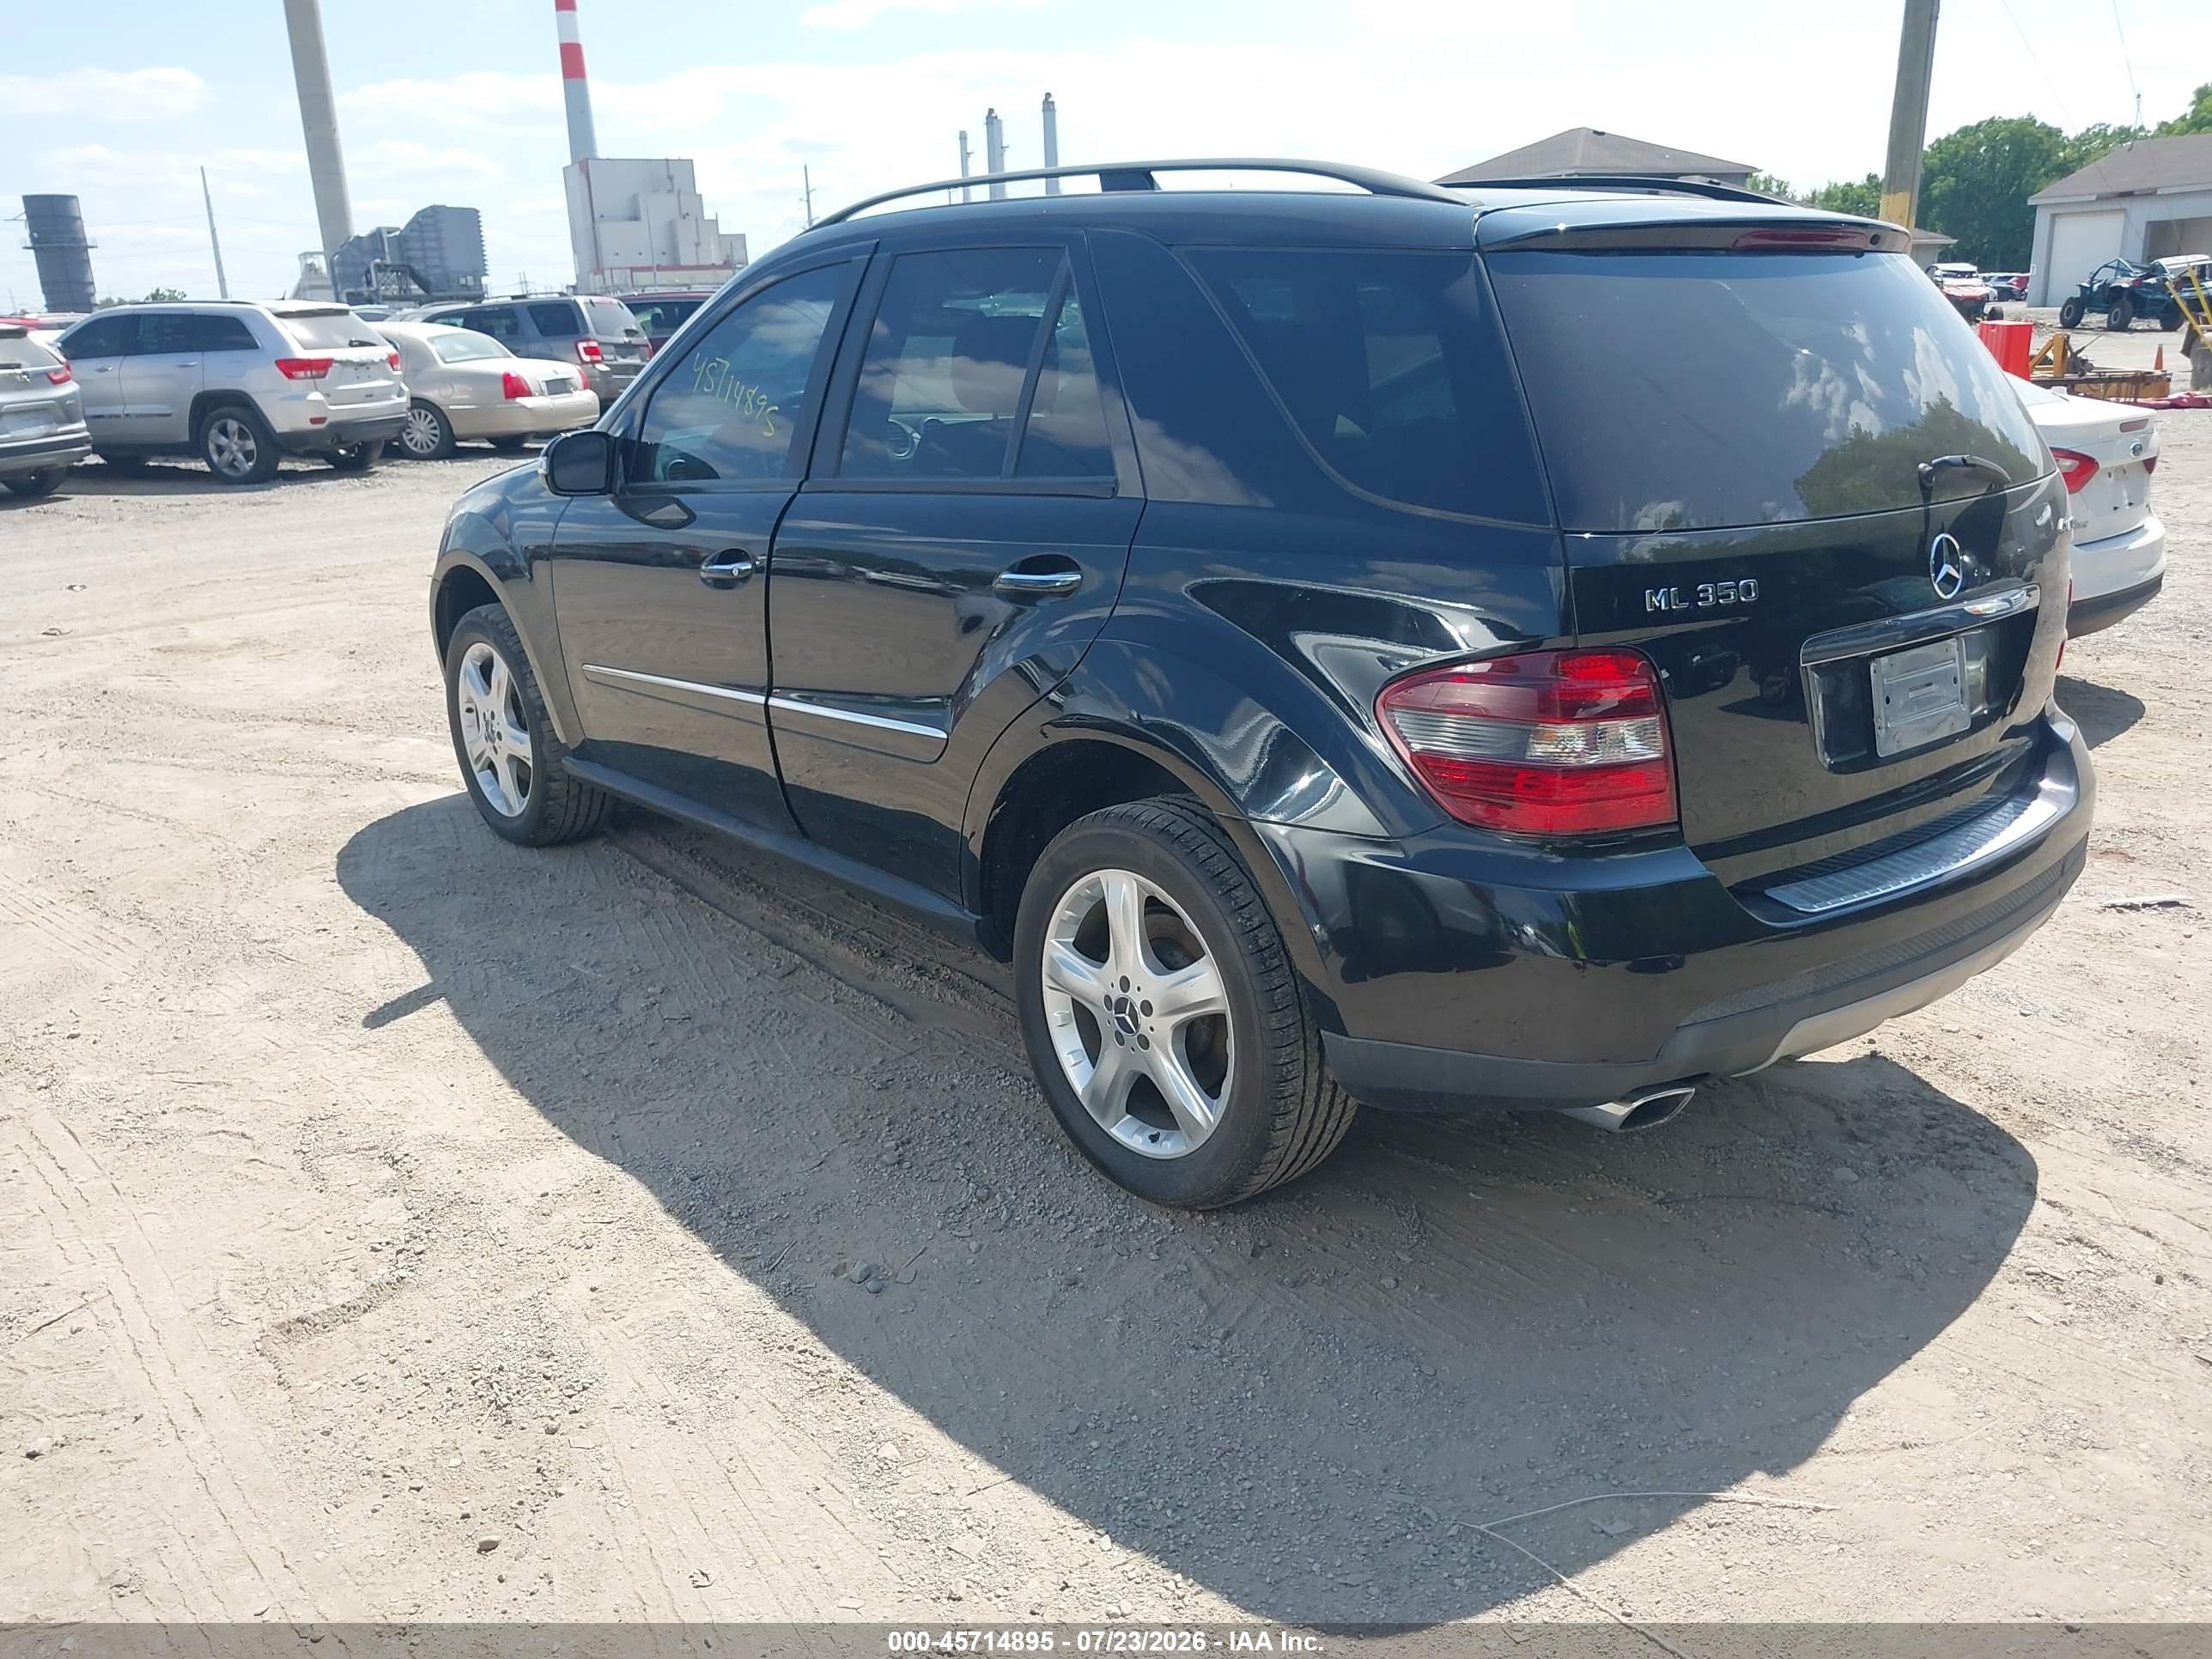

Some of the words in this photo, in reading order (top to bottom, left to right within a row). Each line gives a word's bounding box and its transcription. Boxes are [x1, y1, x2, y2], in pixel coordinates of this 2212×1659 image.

[693, 352, 780, 437] 45714895
[1644, 586, 1690, 611] ML
[1696, 579, 1759, 606] 350
